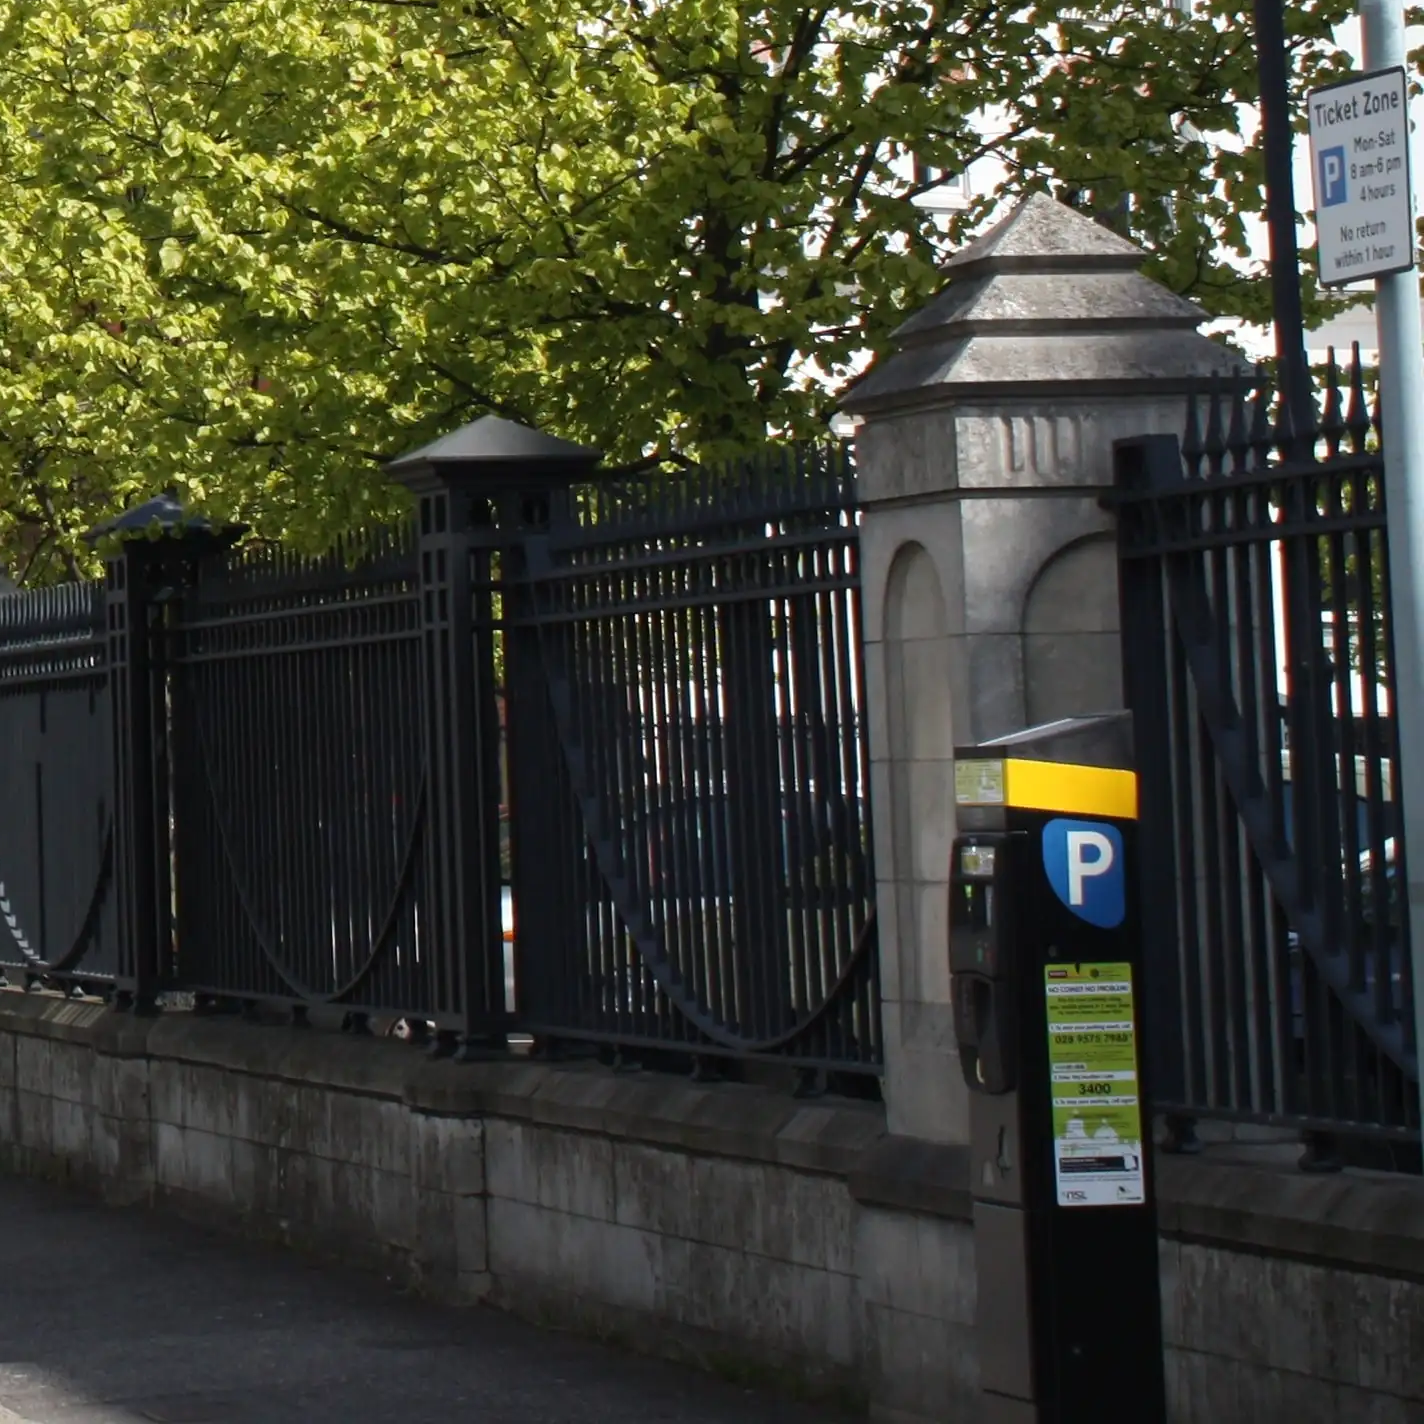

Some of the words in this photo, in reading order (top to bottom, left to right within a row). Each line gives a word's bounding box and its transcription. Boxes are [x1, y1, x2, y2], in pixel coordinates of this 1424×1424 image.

[1314, 99, 1359, 127] Ticket
[1363, 90, 1399, 116] Zone
[1354, 131, 1395, 153] Mon-Sat
[1323, 155, 1339, 199] P
[1350, 162, 1357, 179] 8
[1359, 157, 1384, 178] am-6
[1386, 156, 1401, 173] pm
[1360, 186, 1366, 202] 4
[1368, 183, 1396, 201] hours
[1340, 225, 1353, 242] No
[1357, 220, 1386, 239] return
[1334, 250, 1364, 269] within
[1372, 243, 1395, 262] hour
[1067, 830, 1113, 905] P
[1079, 1083, 1111, 1094] 3400
